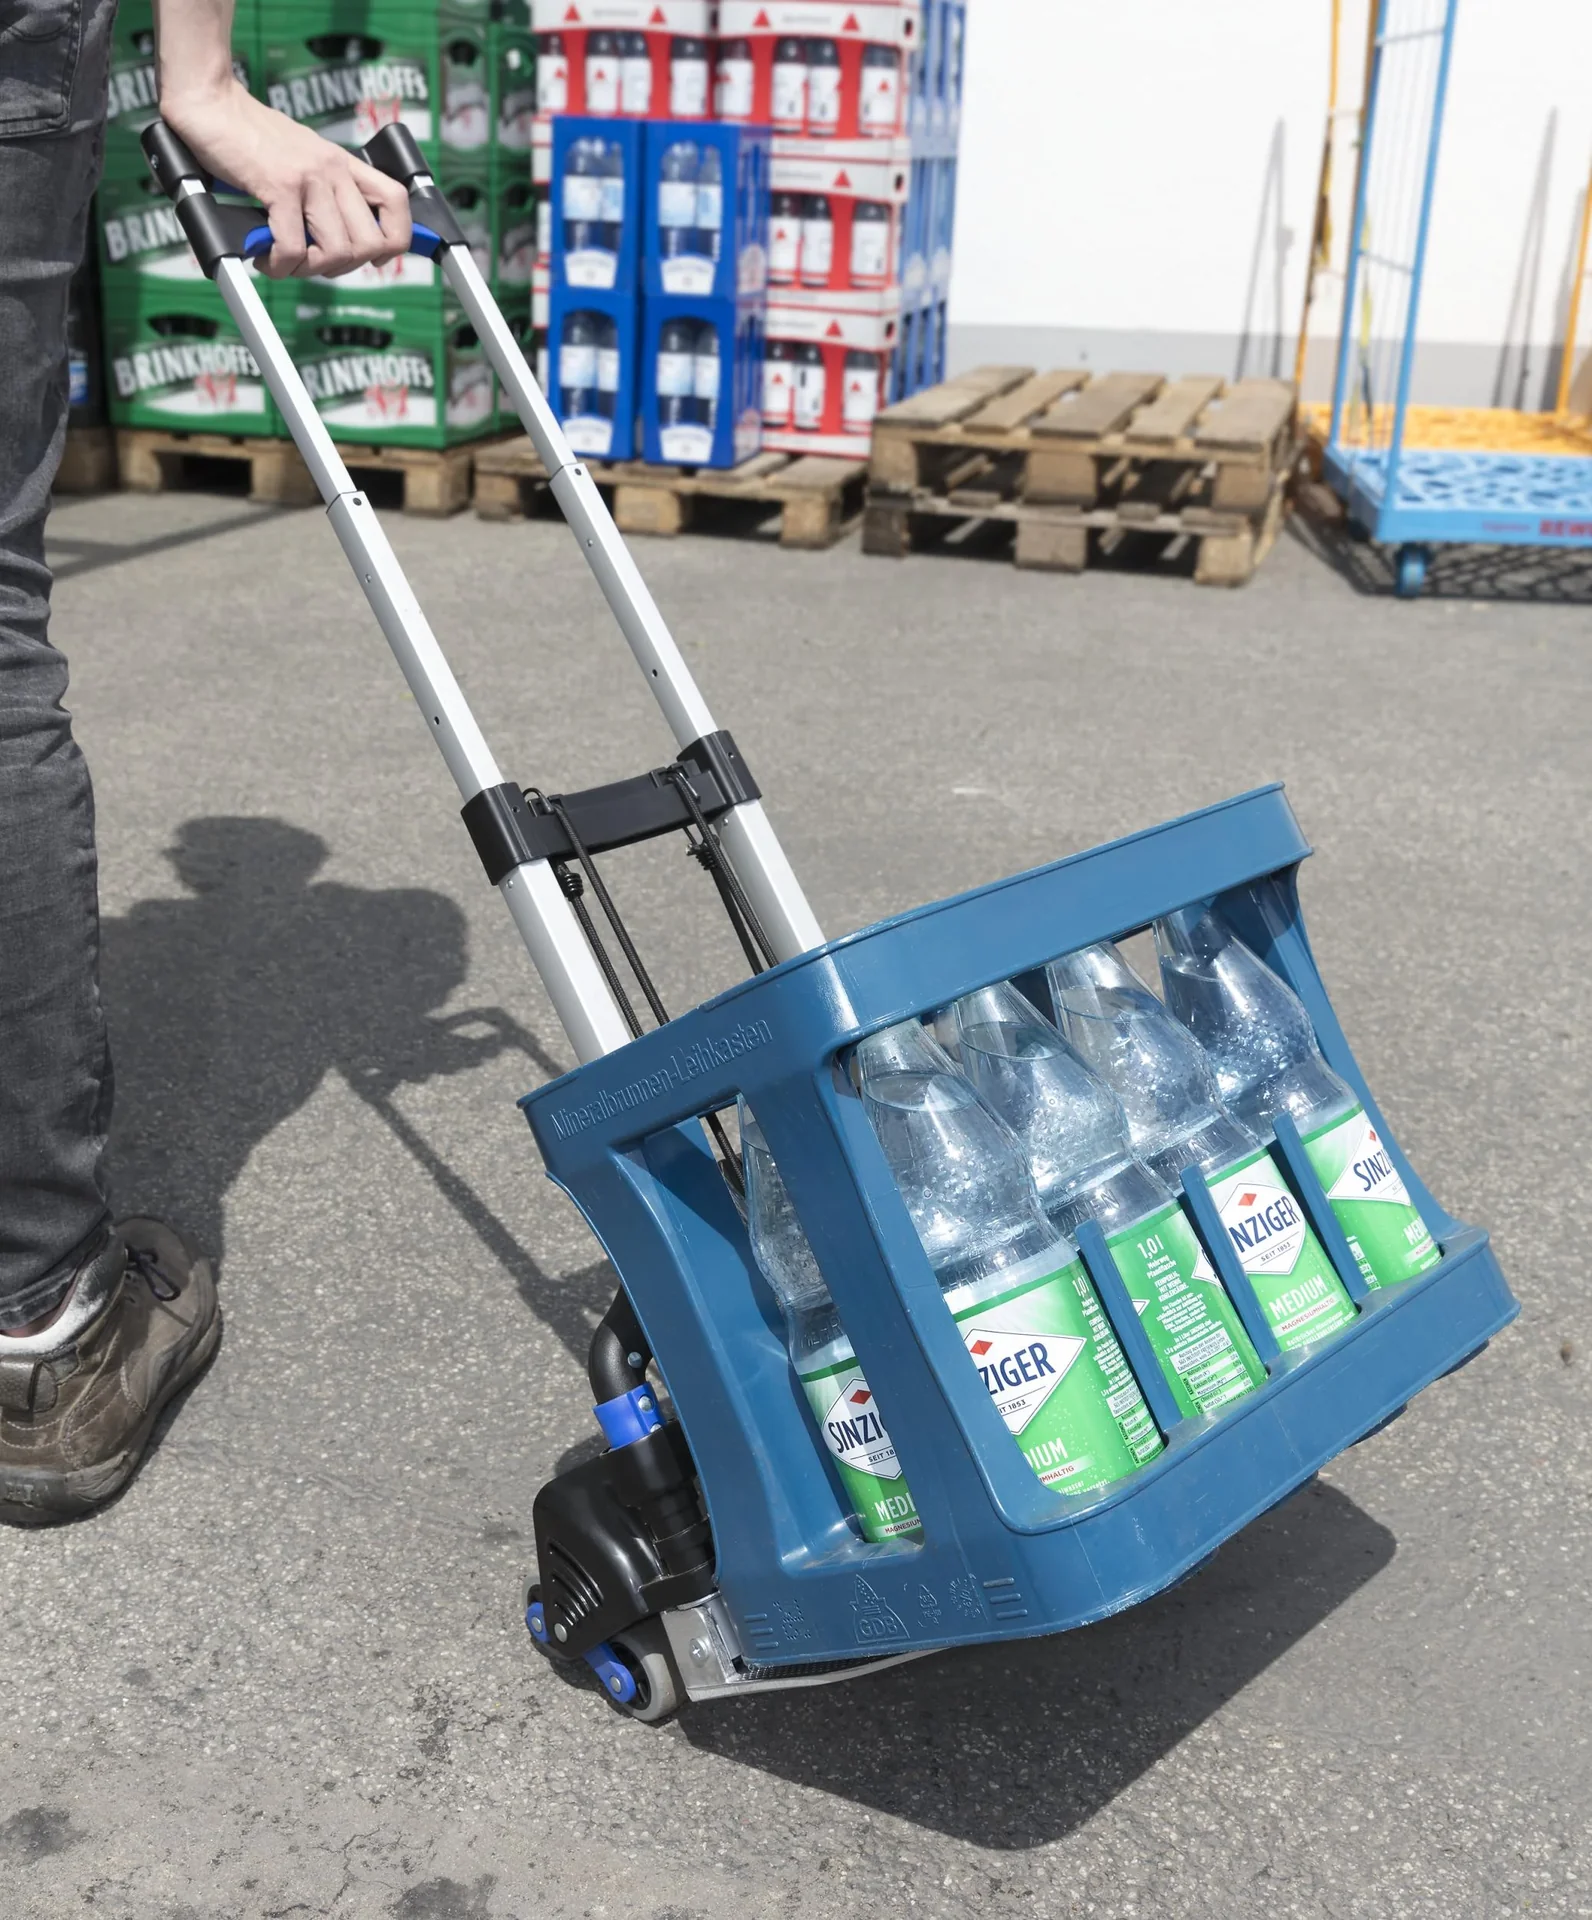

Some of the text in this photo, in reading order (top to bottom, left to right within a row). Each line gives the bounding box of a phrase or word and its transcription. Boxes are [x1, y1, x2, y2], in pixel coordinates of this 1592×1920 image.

[1229, 1195, 1301, 1254] NZIGER
[1260, 1250, 1276, 1262] SEIT
[1268, 1274, 1329, 1321] MEDIUM
[978, 1342, 1056, 1395] ZIGER
[1008, 1399, 1026, 1411] 1853
[828, 1412, 883, 1454] SINZI
[868, 1454, 884, 1462] SEIT
[874, 1492, 916, 1522] MEDI
[860, 1615, 898, 1636] GDB
